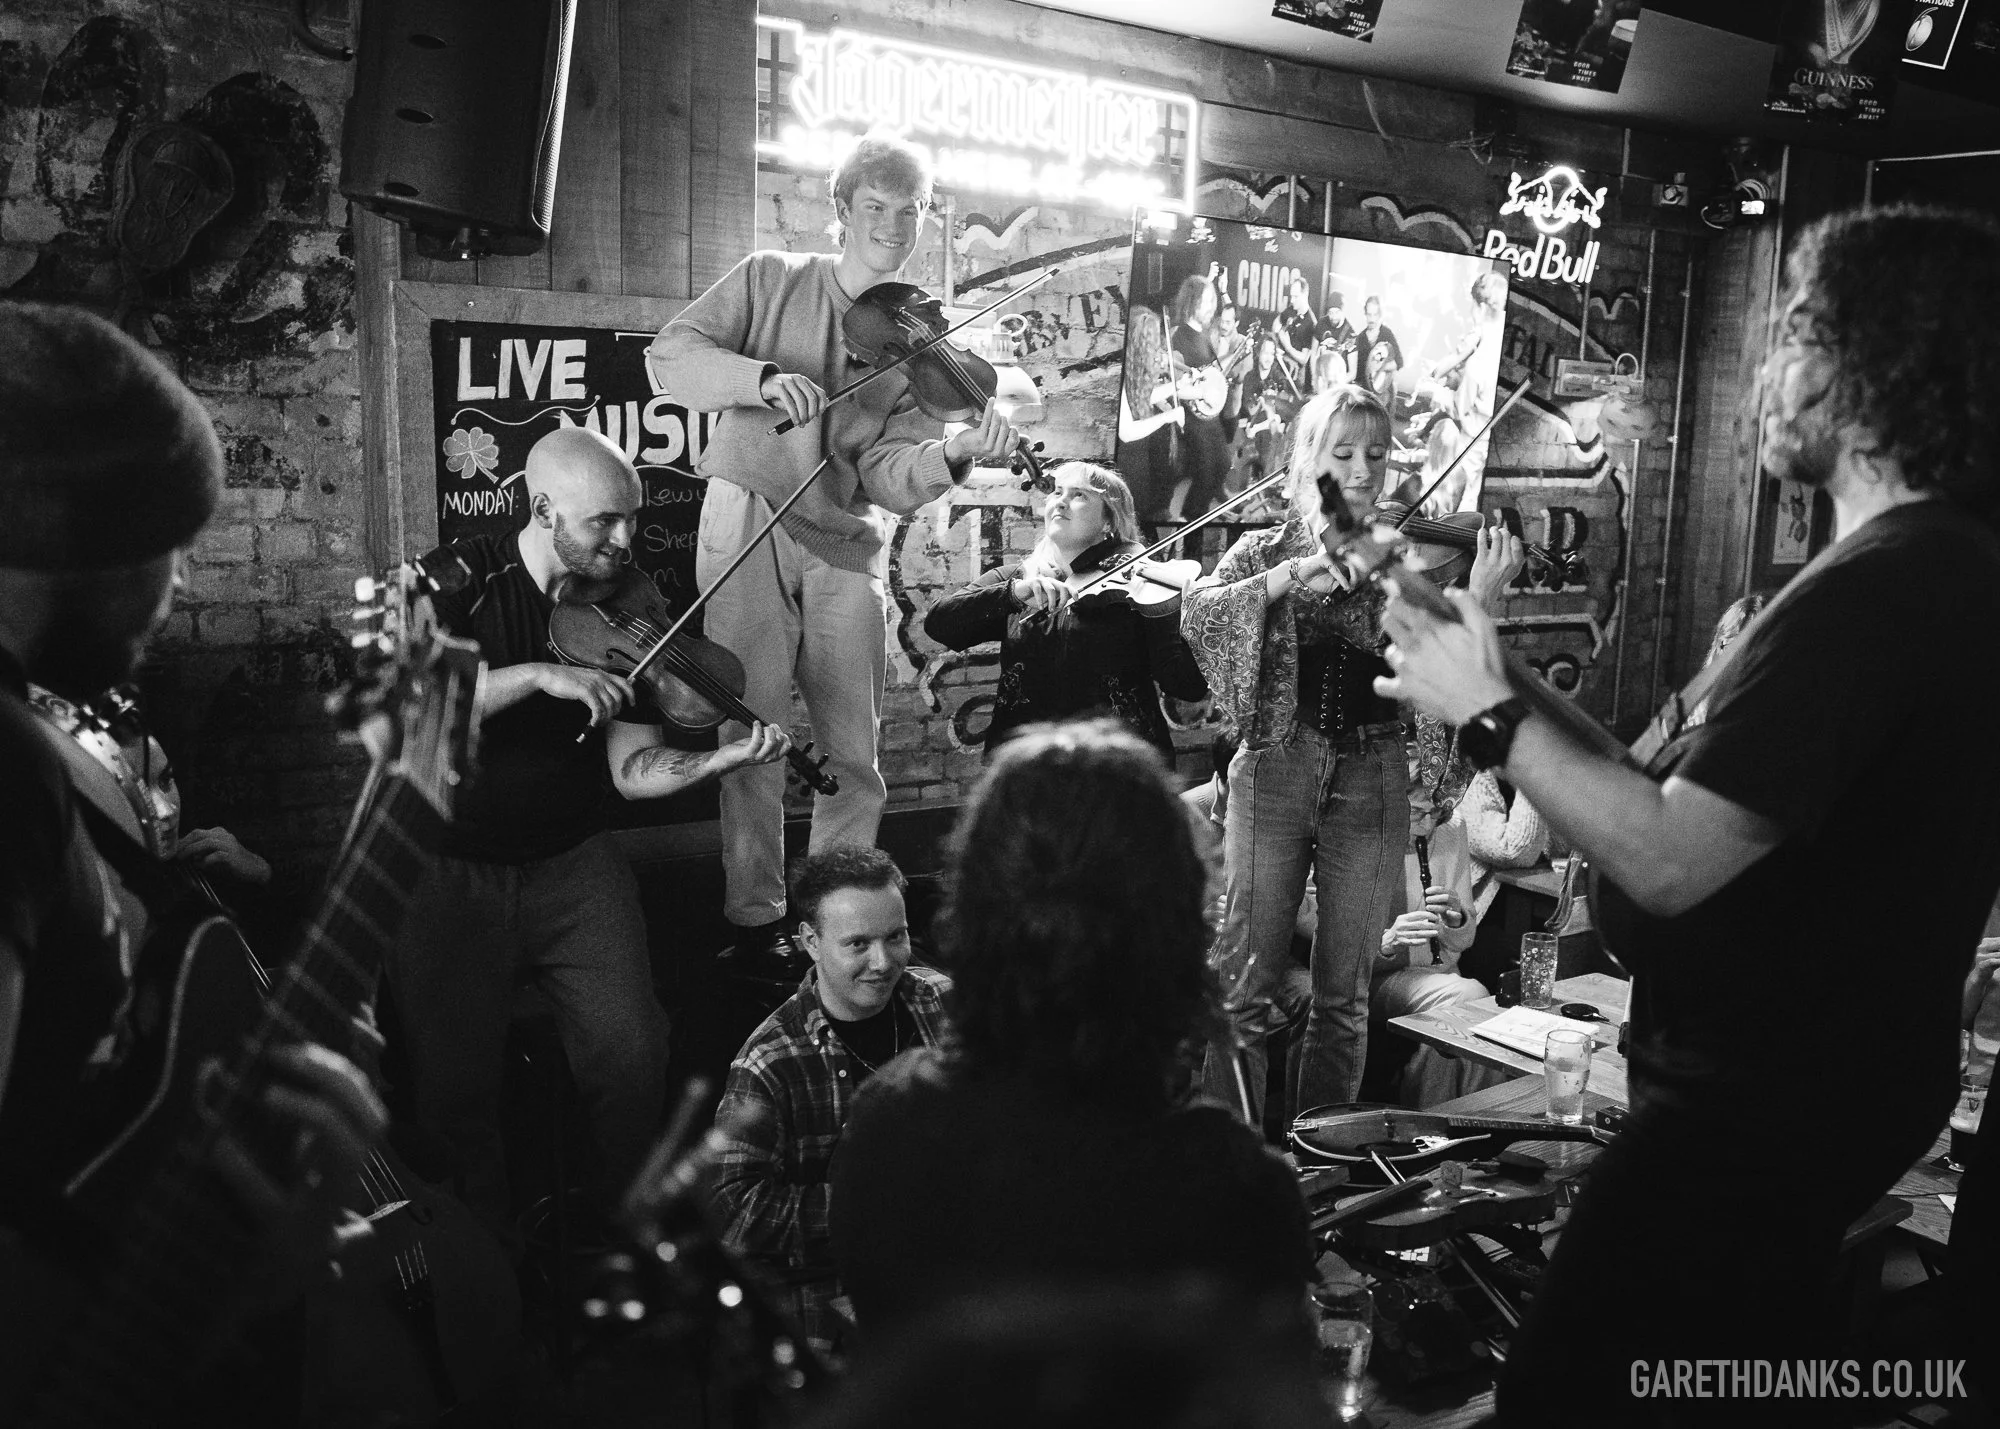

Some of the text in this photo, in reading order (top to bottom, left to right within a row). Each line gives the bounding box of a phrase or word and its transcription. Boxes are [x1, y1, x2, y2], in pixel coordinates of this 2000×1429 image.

[1346, 24, 1365, 33] AWAIT
[1353, 19, 1371, 29] TIMES
[1577, 68, 1597, 77] TIMES
[1571, 75, 1592, 83] AWAIT
[1793, 67, 1875, 91] GUINNESS
[1864, 106, 1886, 114] TIMES
[1857, 113, 1880, 121] AWAIT
[1540, 237, 1600, 283] Bull
[457, 337, 587, 401] LIVE
